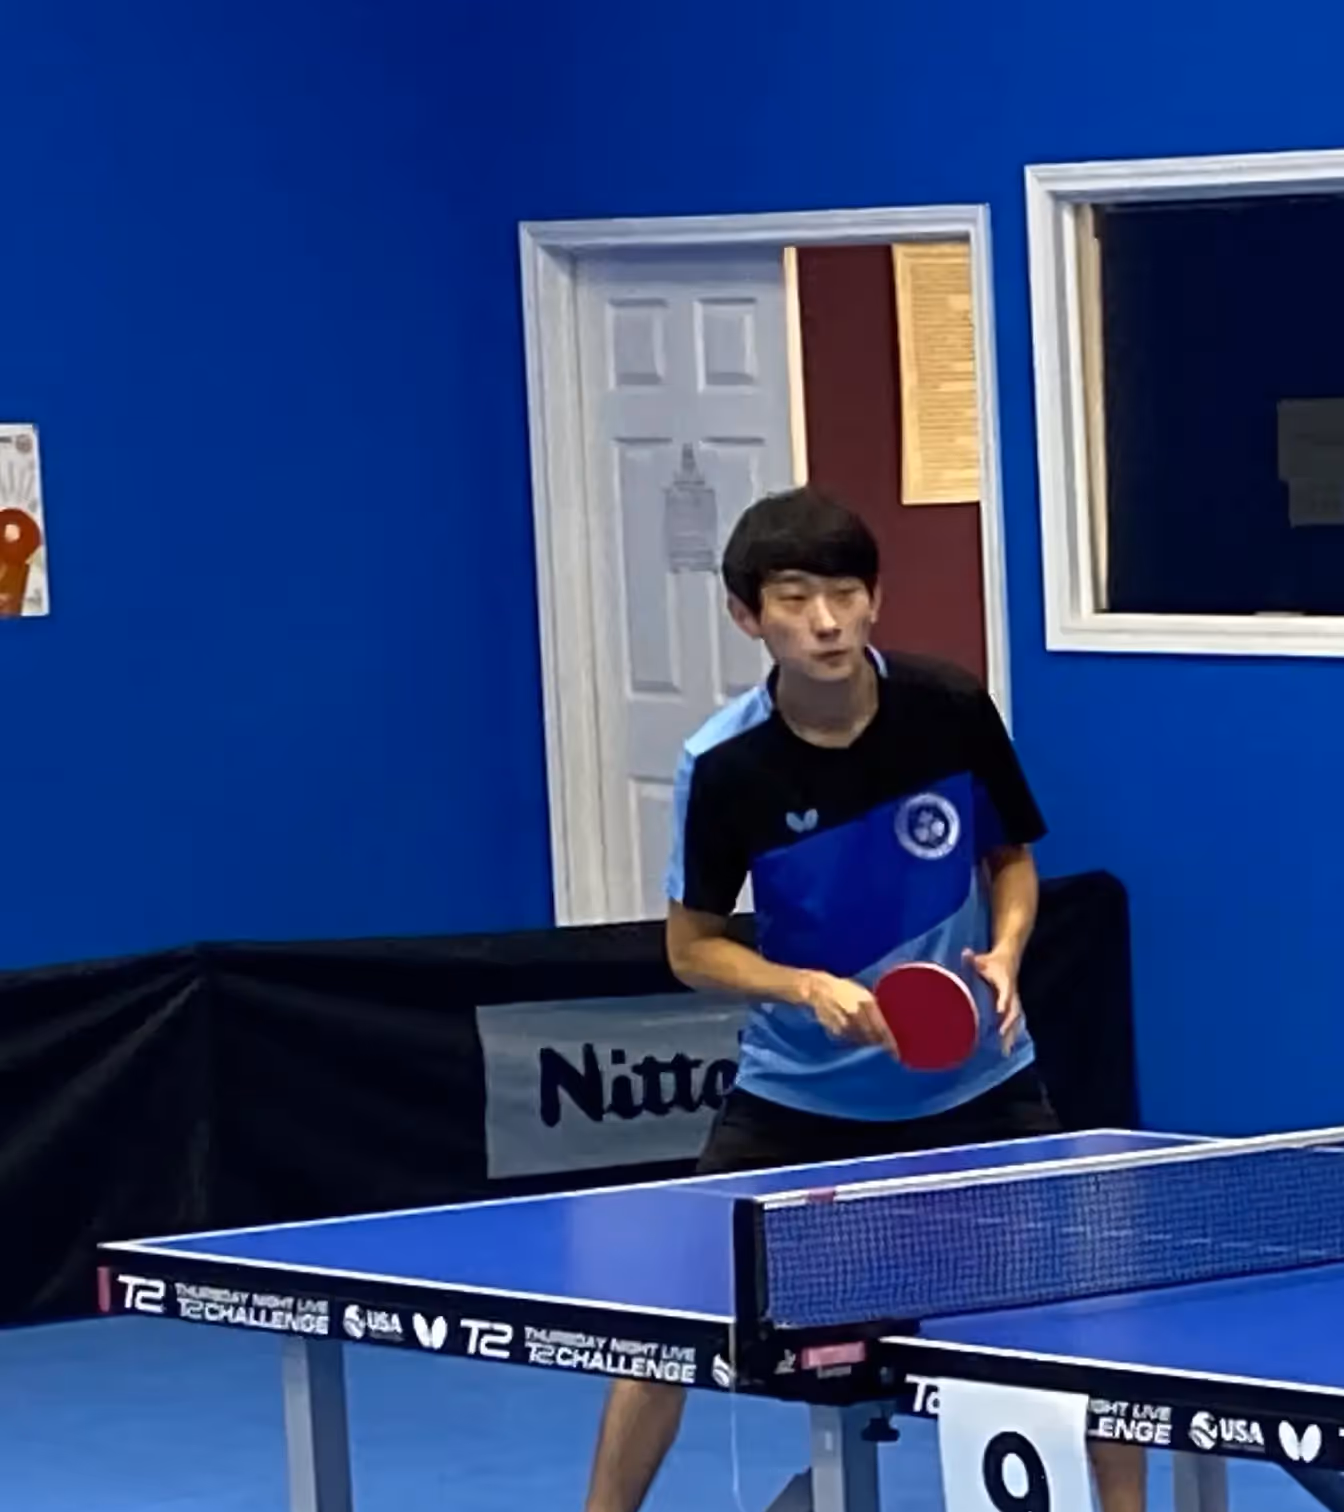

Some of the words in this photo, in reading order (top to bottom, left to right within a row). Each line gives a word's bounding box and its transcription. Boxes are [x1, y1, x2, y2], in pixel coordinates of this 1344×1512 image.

[118, 1274, 165, 1314] T2
[366, 1310, 403, 1334] USA
[460, 1318, 513, 1359] T2
[661, 1343, 695, 1363] LIVE
[1219, 1417, 1265, 1445] USA
